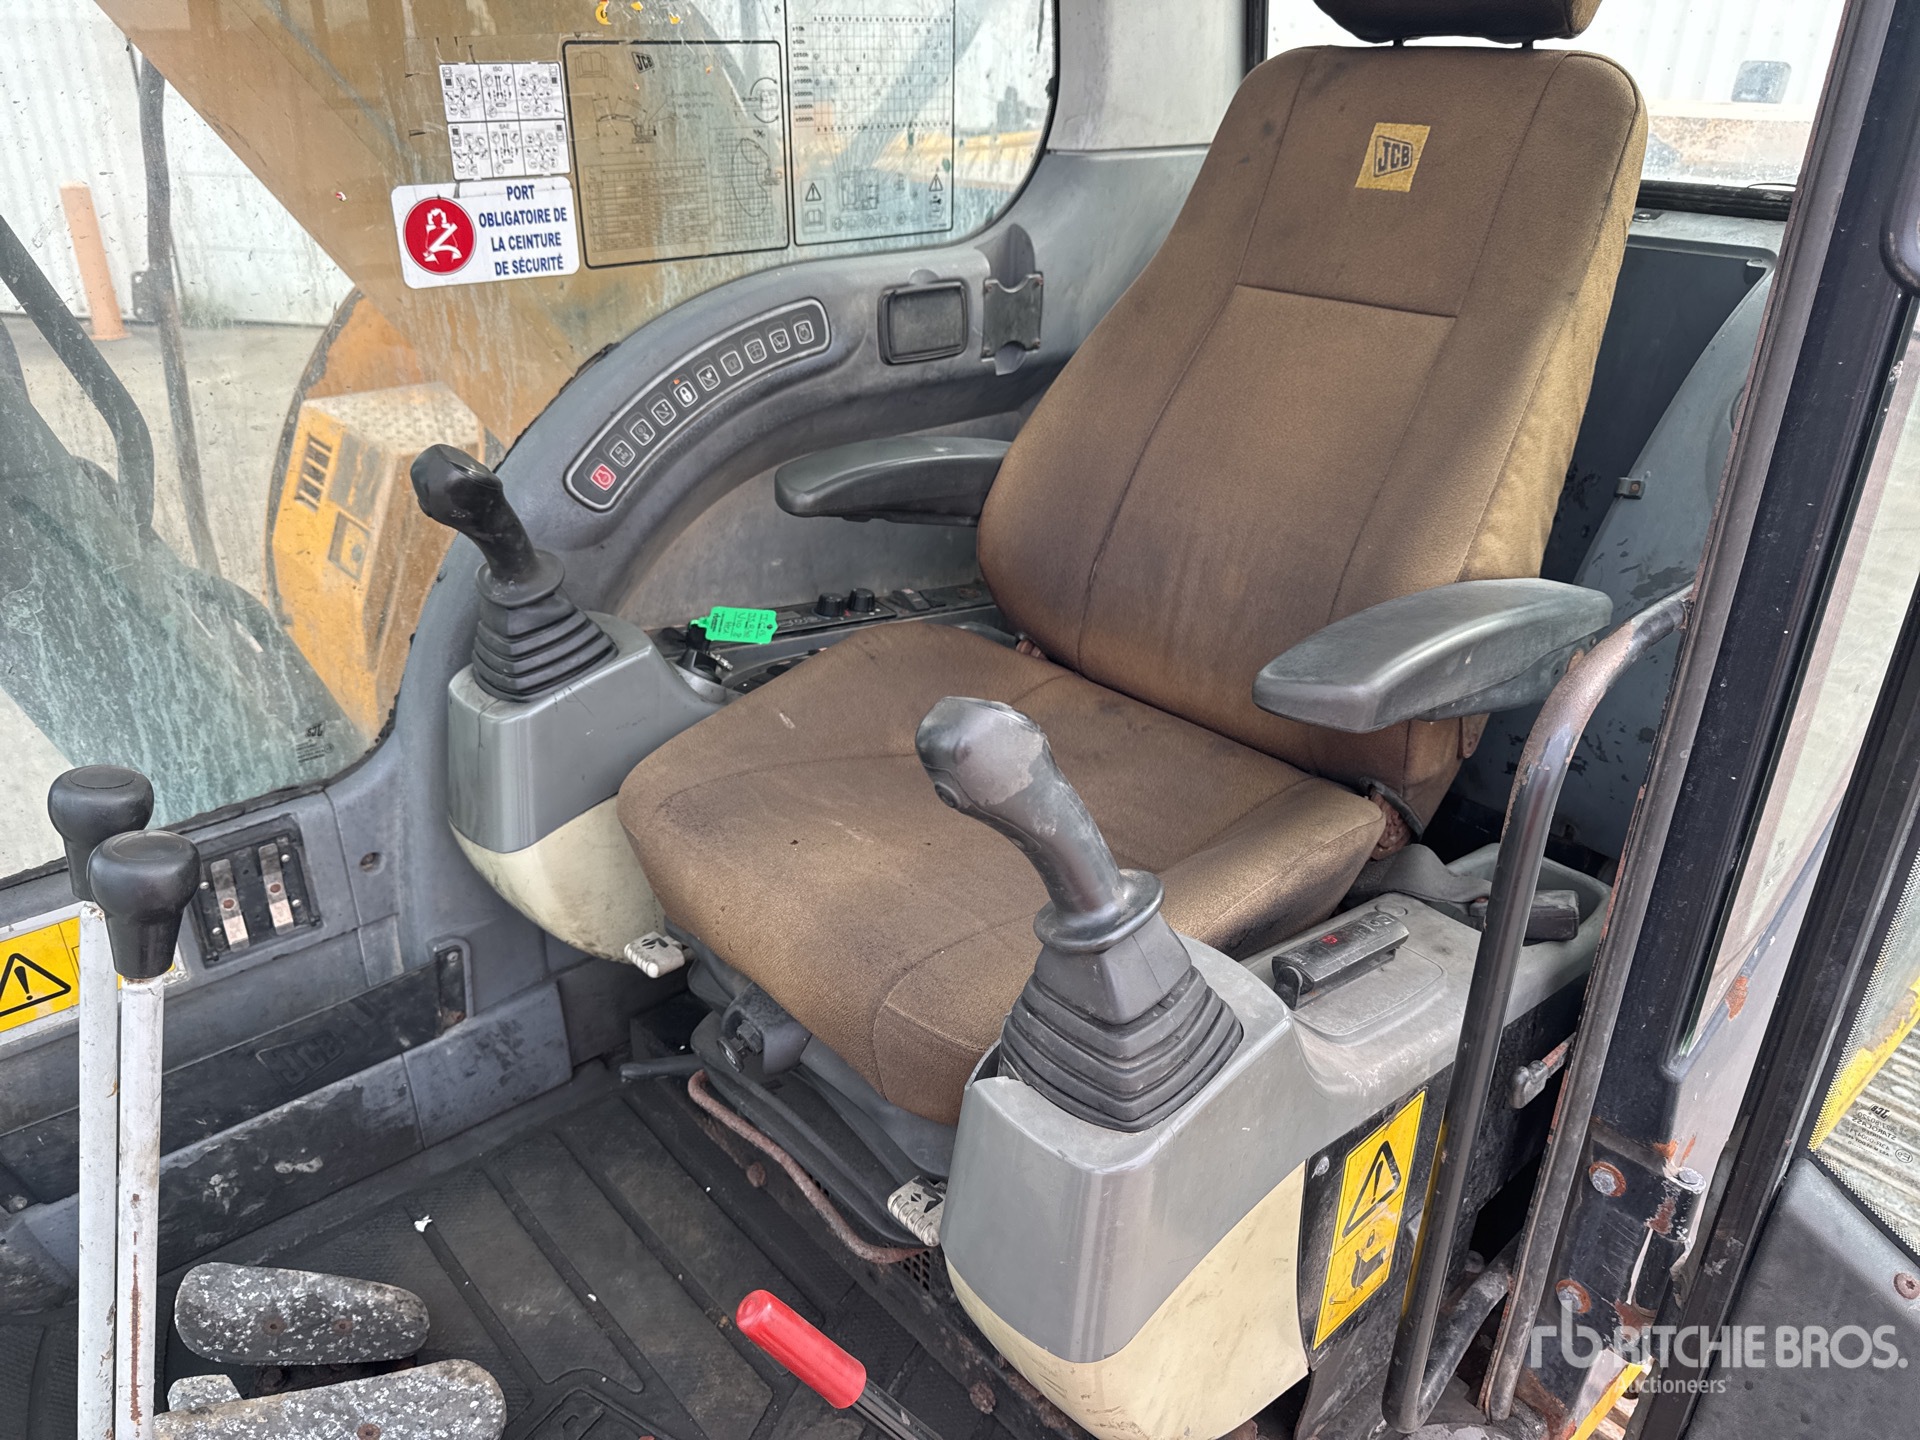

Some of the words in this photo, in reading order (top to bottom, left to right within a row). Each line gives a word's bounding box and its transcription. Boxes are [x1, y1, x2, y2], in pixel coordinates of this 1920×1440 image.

[636, 55, 653, 71] JCB
[1377, 141, 1410, 173] JCB
[506, 184, 535, 201] PORT
[478, 209, 551, 228] OBLIGATOIRE
[554, 207, 567, 222] DE
[491, 237, 506, 252] LA
[508, 232, 562, 249] CEINTURE
[494, 261, 510, 276] DE
[512, 253, 564, 274] SÉCURITÉ
